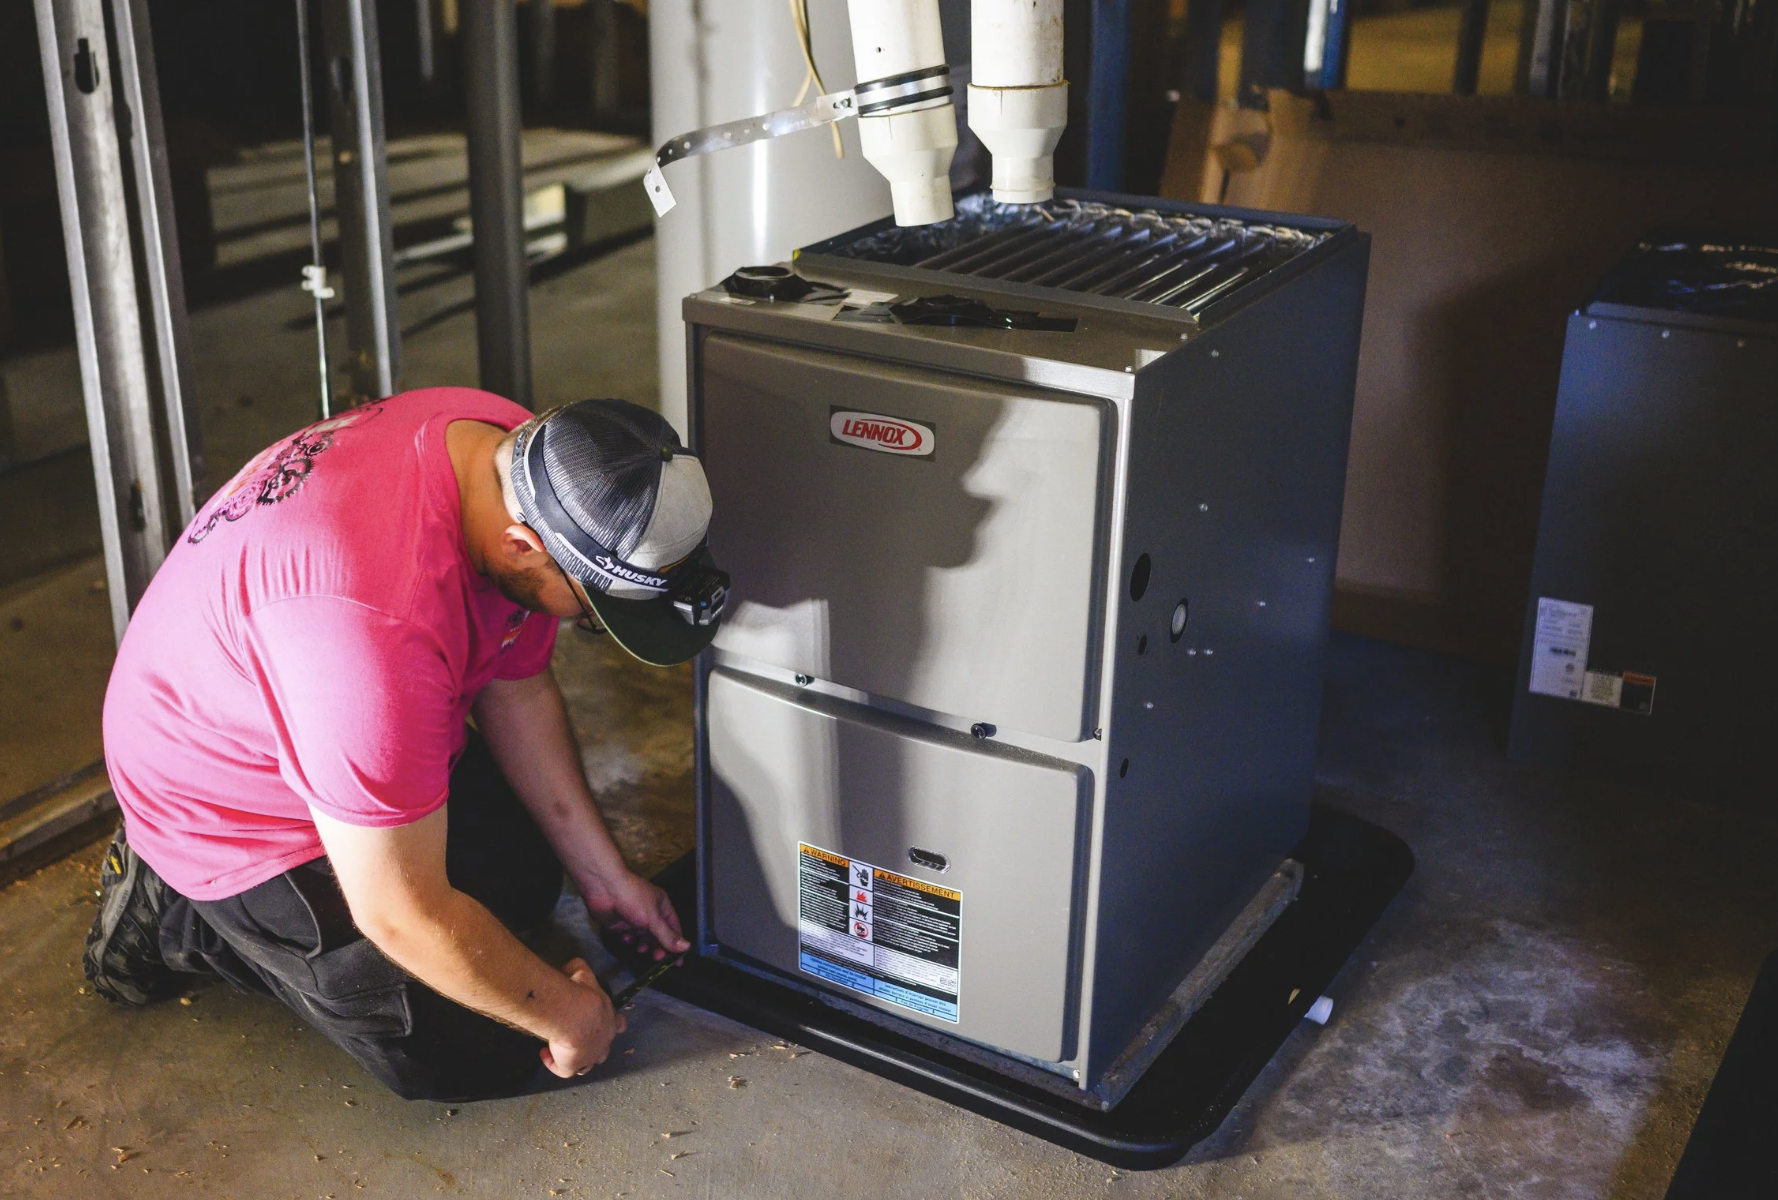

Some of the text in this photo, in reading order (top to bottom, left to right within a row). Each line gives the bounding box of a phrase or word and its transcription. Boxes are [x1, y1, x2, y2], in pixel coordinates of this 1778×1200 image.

[842, 419, 907, 445] LENNOX
[612, 565, 668, 587] HUSKY
[811, 849, 846, 867] WARNING
[886, 872, 955, 899] AVERTISSEMENT
